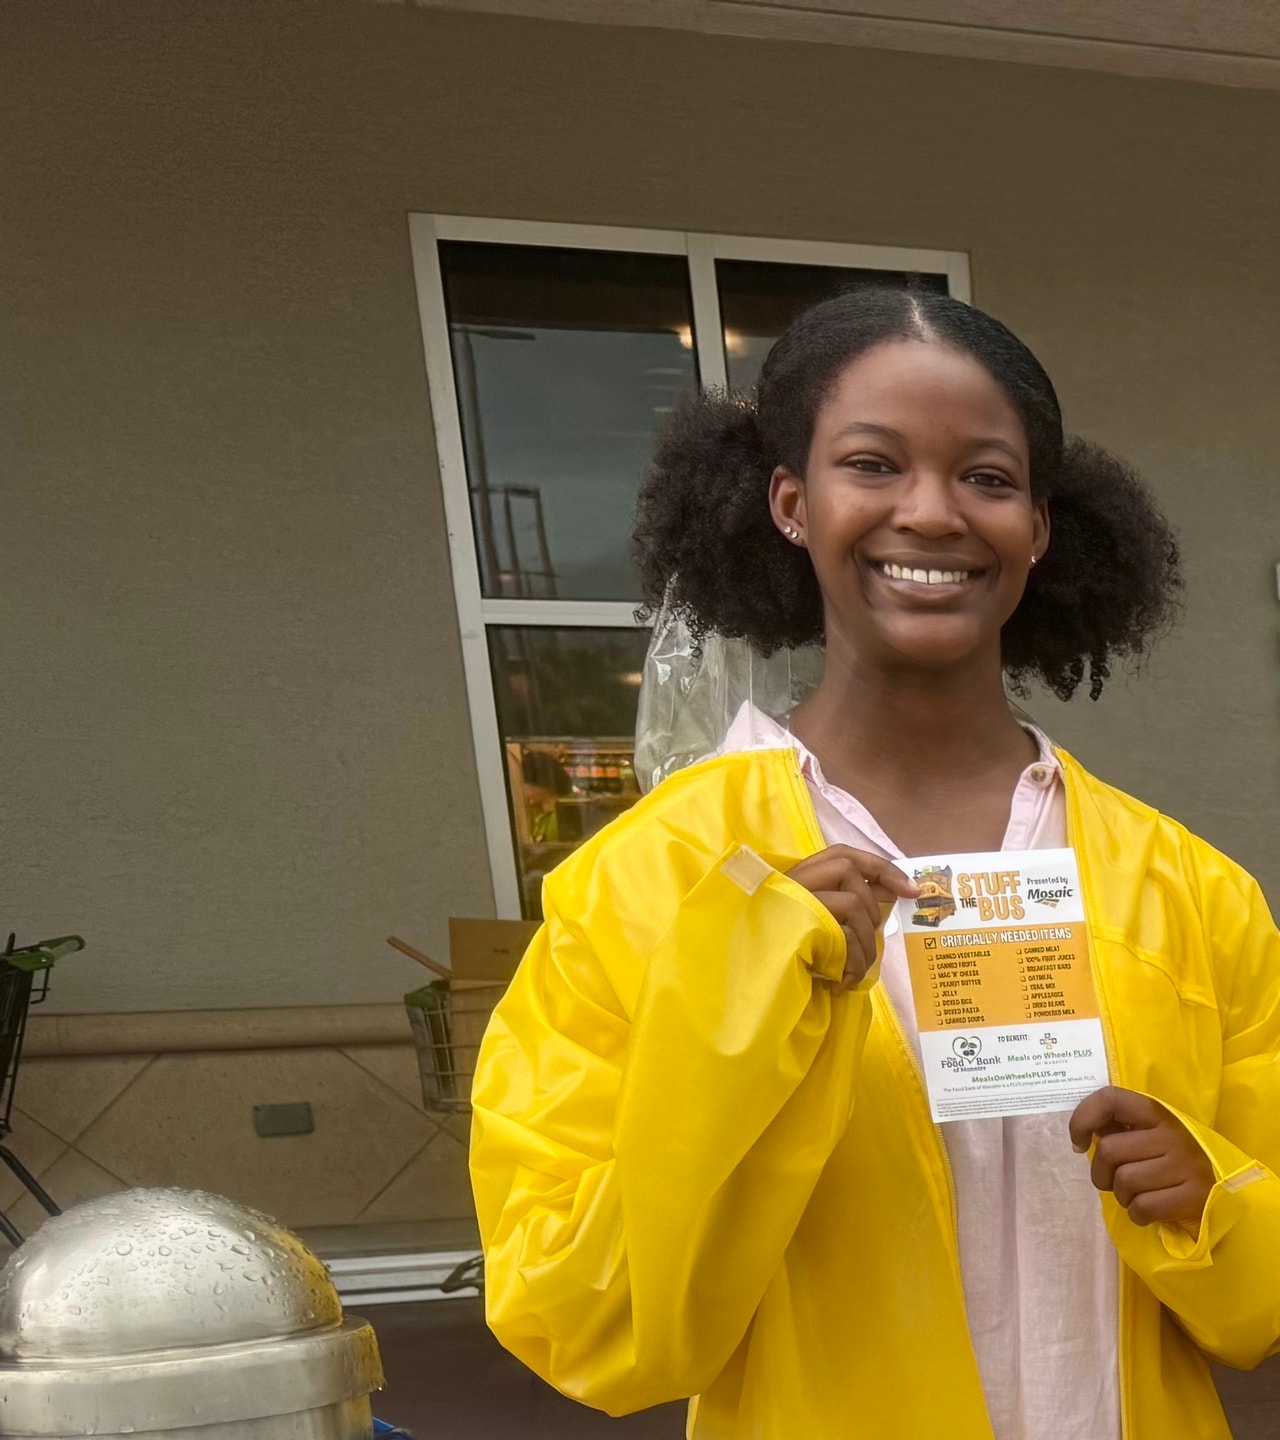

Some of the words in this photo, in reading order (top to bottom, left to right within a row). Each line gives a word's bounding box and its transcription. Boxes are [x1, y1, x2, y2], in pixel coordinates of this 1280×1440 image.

[956, 870, 1022, 899] STUFF
[1027, 886, 1074, 900] Mosaic
[960, 897, 977, 909] THE
[979, 896, 1026, 921] BUS
[940, 932, 998, 948] CRITICALLY
[1000, 930, 1039, 943] NEEDED
[1040, 927, 1072, 940] ITEMS
[976, 1056, 1001, 1066] Bank
[1073, 1049, 1093, 1058] PLUS
